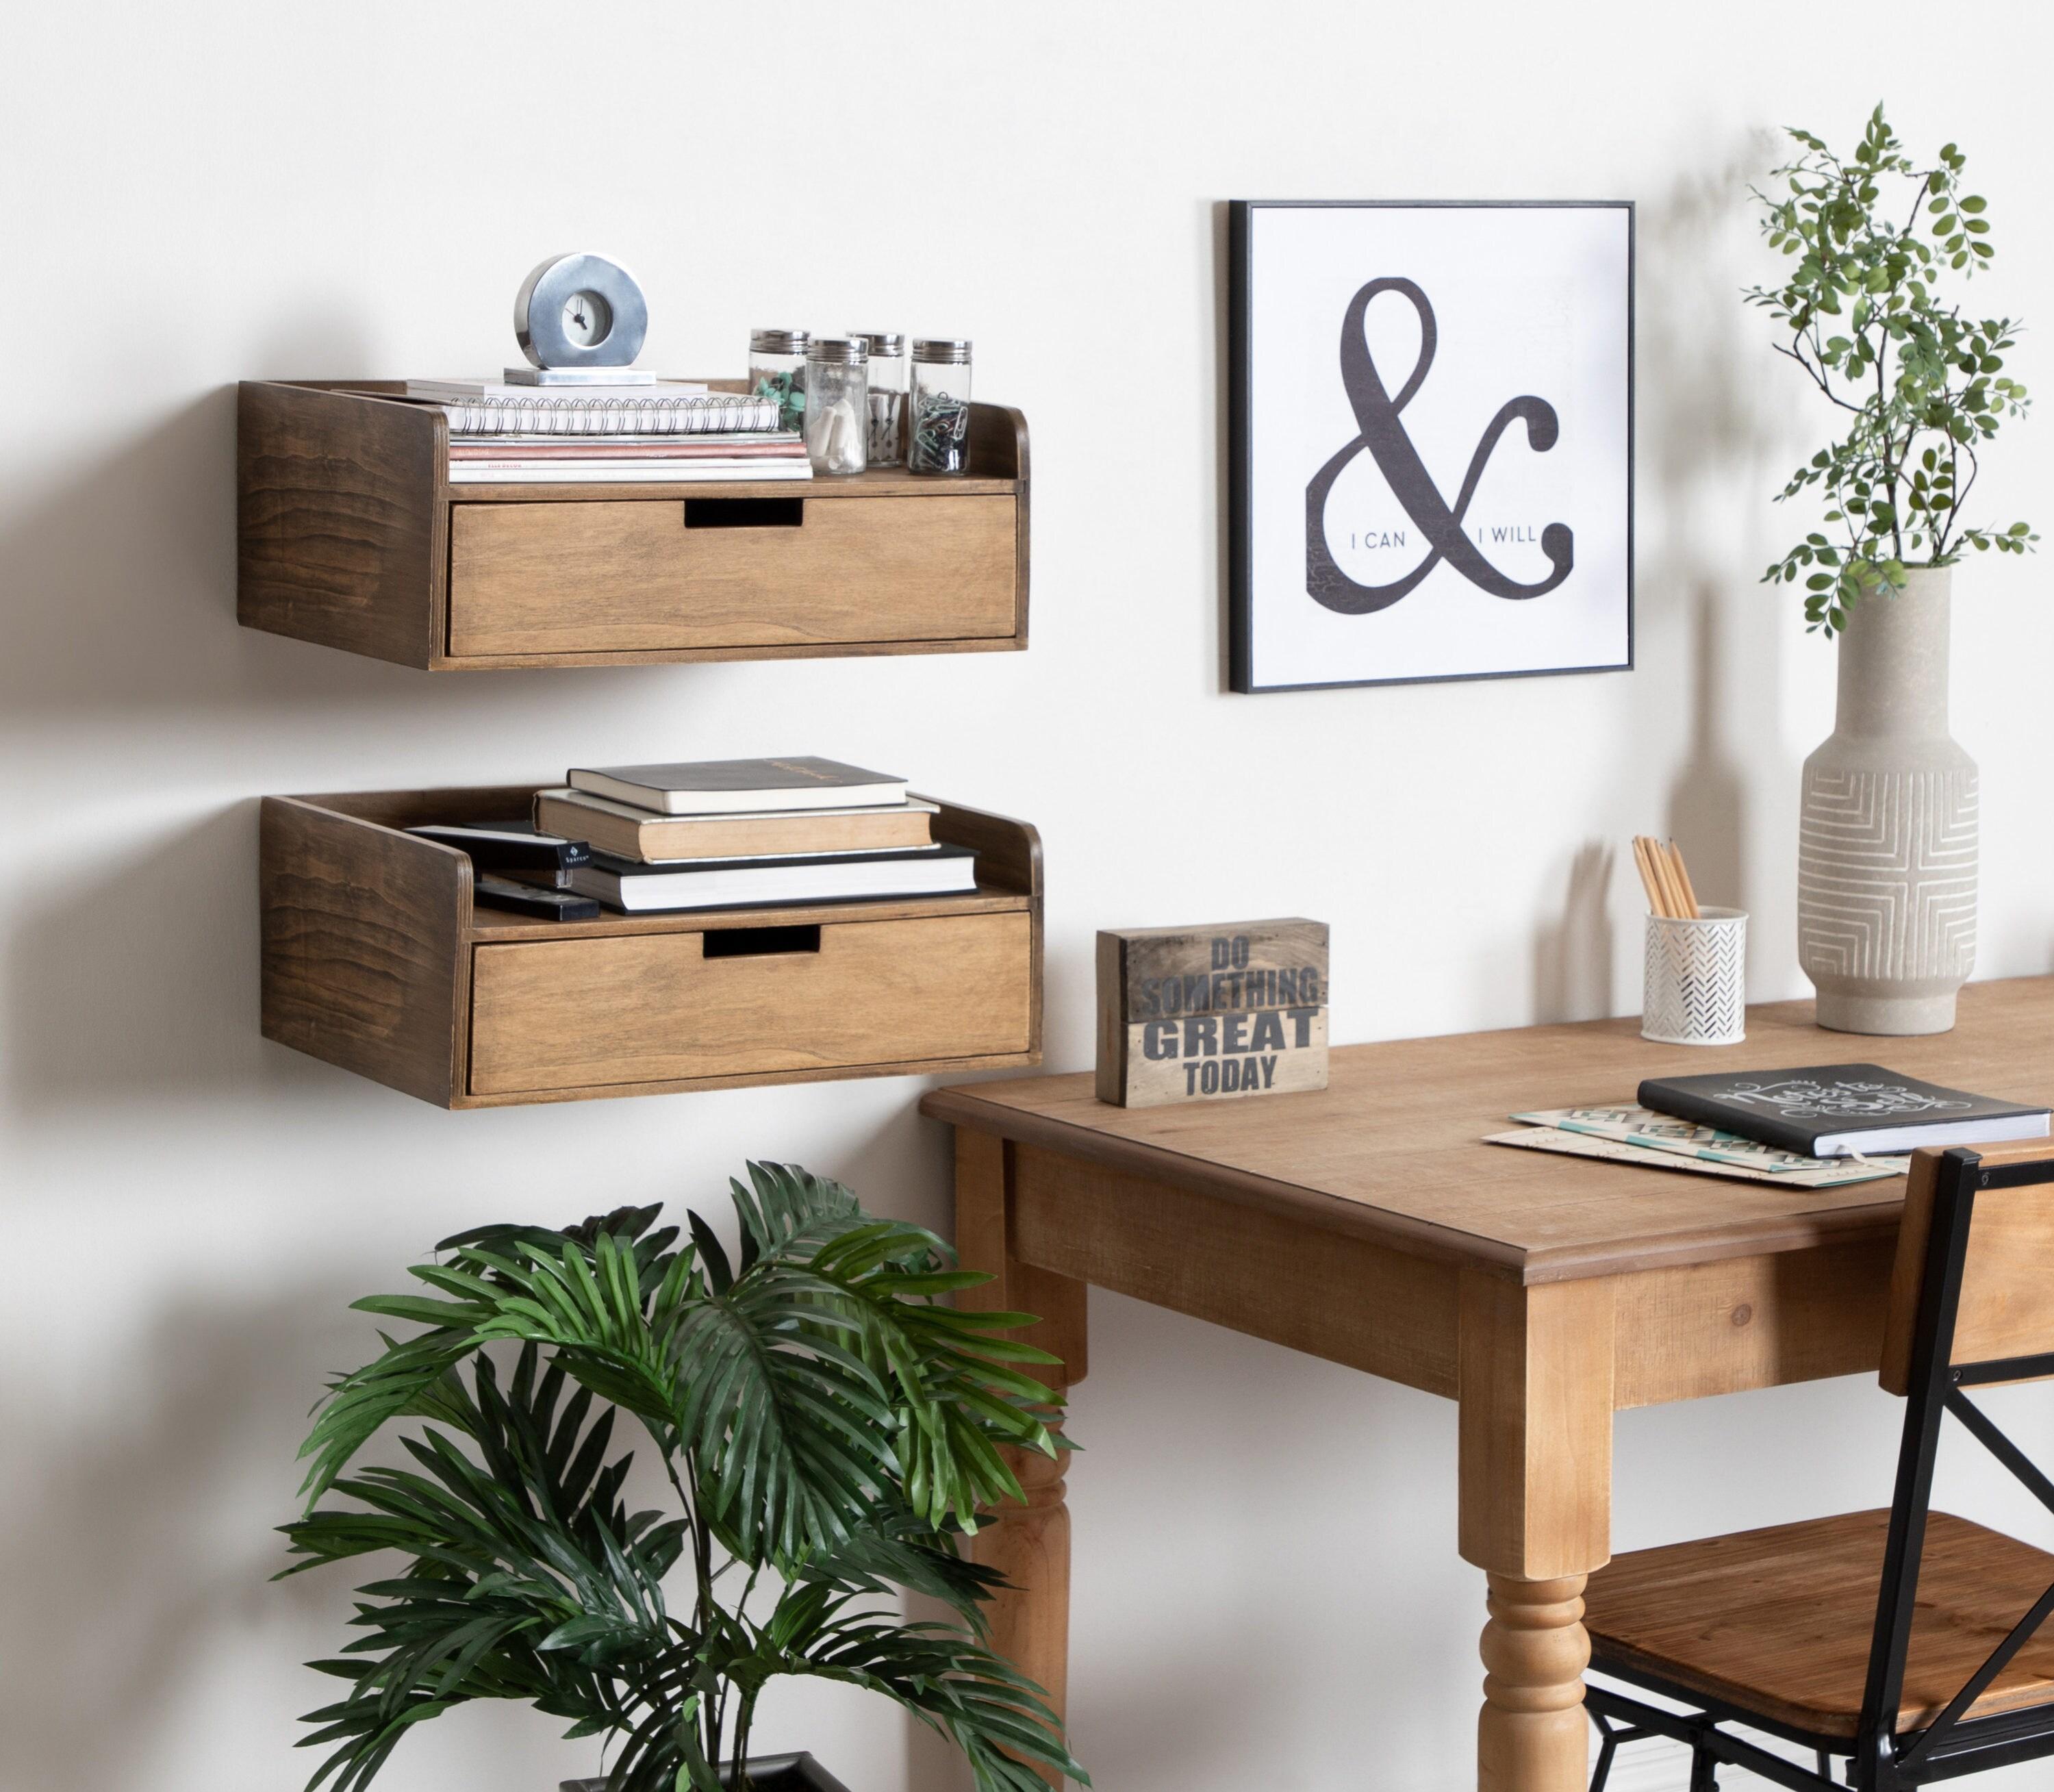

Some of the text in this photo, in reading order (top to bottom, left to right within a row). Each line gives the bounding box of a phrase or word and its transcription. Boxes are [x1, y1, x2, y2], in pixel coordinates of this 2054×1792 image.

[1306, 277, 1573, 615] I CAN & I WILL
[1211, 935, 1250, 971] DO
[1141, 967, 1319, 1015] SOMETHING
[1143, 1008, 1319, 1061] GREAT
[1183, 1055, 1278, 1096] TODAY
